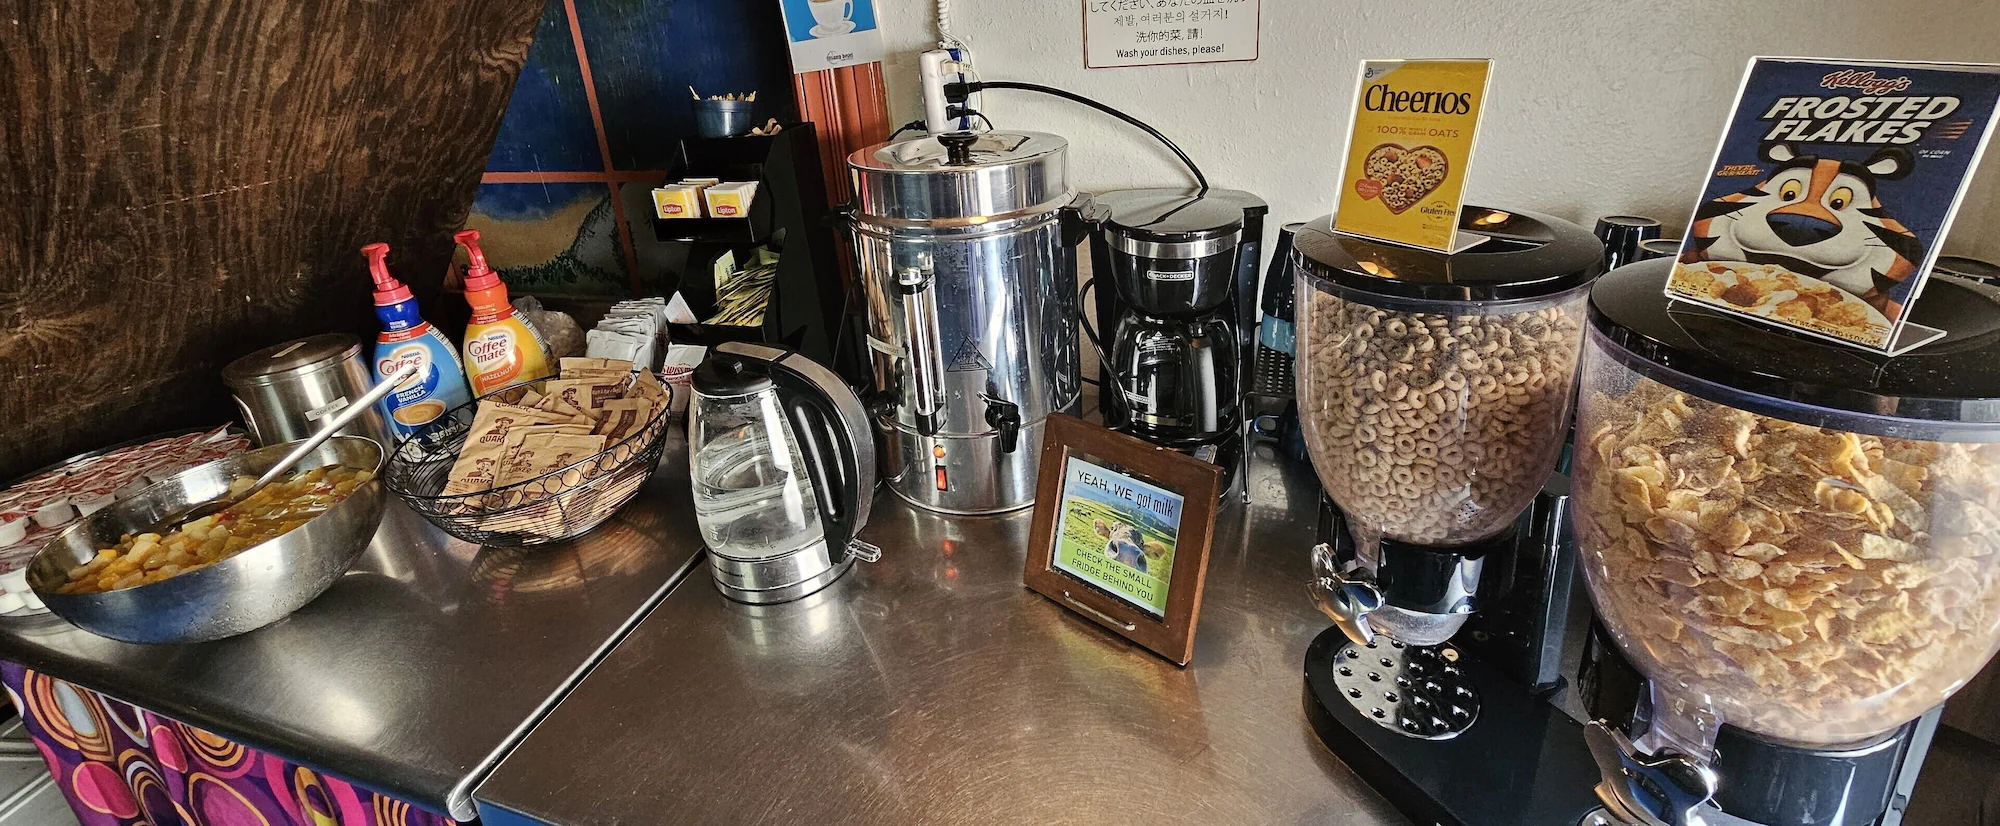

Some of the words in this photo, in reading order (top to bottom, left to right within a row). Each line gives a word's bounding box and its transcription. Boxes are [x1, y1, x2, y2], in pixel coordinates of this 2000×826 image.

[1116, 48, 1139, 58] Wash
[1140, 49, 1158, 59] your
[1160, 46, 1190, 57] dishes,
[1192, 44, 1224, 56] please!
[1820, 70, 1912, 95] Kellogg's
[1365, 84, 1471, 115] Cheerios
[1763, 96, 1960, 120] FROSTED
[1377, 125, 1406, 135] 100%
[1428, 128, 1459, 138] OATS
[1765, 120, 1932, 144] FLAKES
[663, 205, 682, 213] Lipton
[717, 206, 736, 214] Lipton
[1420, 206, 1443, 215] Gluten
[468, 339, 507, 357] Coffee
[477, 348, 506, 363] mate
[482, 366, 513, 382] HAZELNUT
[396, 385, 424, 399] FRENCH
[398, 390, 426, 403] VANILLA
[1078, 469, 1110, 494] YEAH,
[1113, 483, 1133, 501] WE
[1136, 493, 1152, 510] got
[1153, 497, 1173, 518] milk
[1076, 548, 1103, 567] CHECK
[1105, 560, 1121, 574] THE
[1123, 569, 1152, 588] SMALL
[1071, 558, 1101, 578] FRIDGE
[1102, 572, 1134, 592] BEHIND
[1136, 587, 1154, 602] YOU
